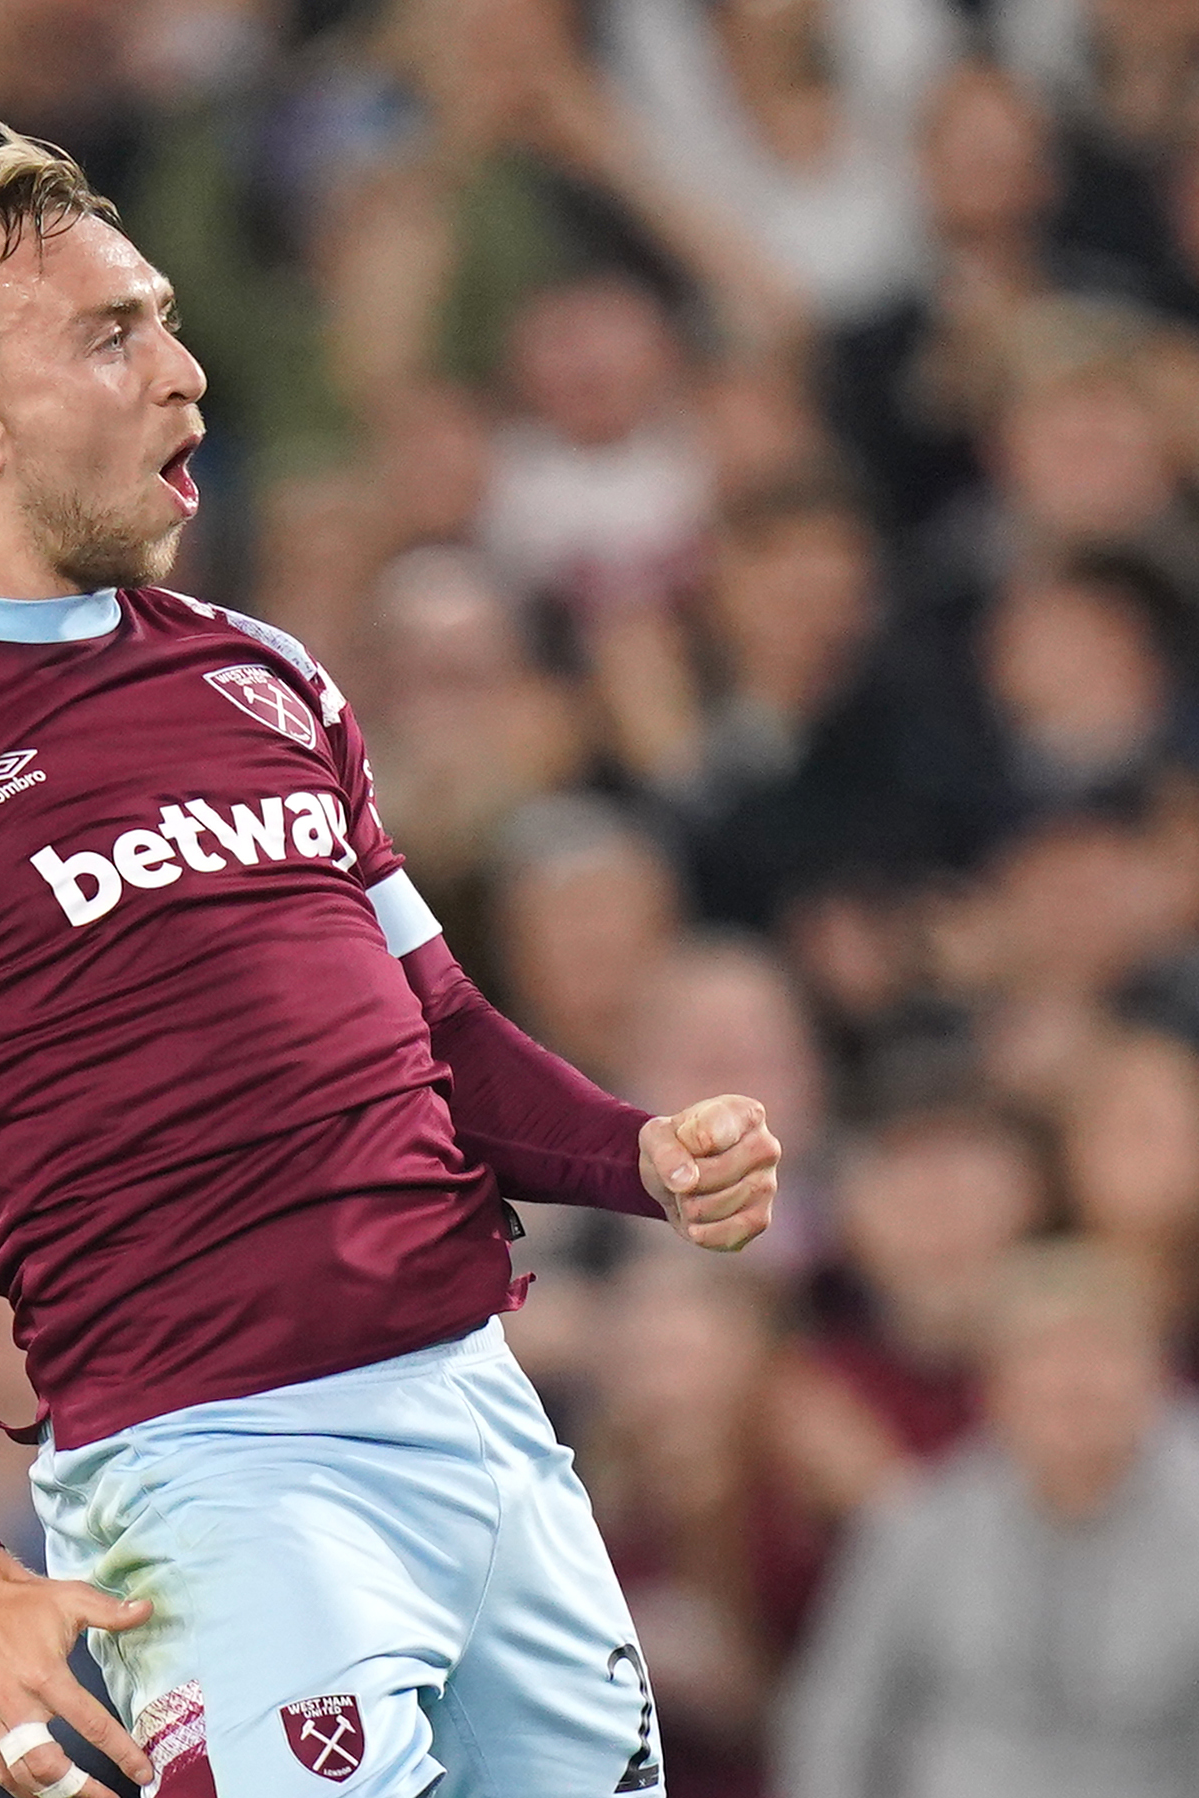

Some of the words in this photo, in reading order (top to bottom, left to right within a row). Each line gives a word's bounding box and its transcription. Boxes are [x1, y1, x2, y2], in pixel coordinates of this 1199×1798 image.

[29, 791, 357, 928] betway
[287, 1698, 322, 1715] WEST
[322, 1695, 354, 1707] HAM
[303, 1705, 343, 1719] UNITED
